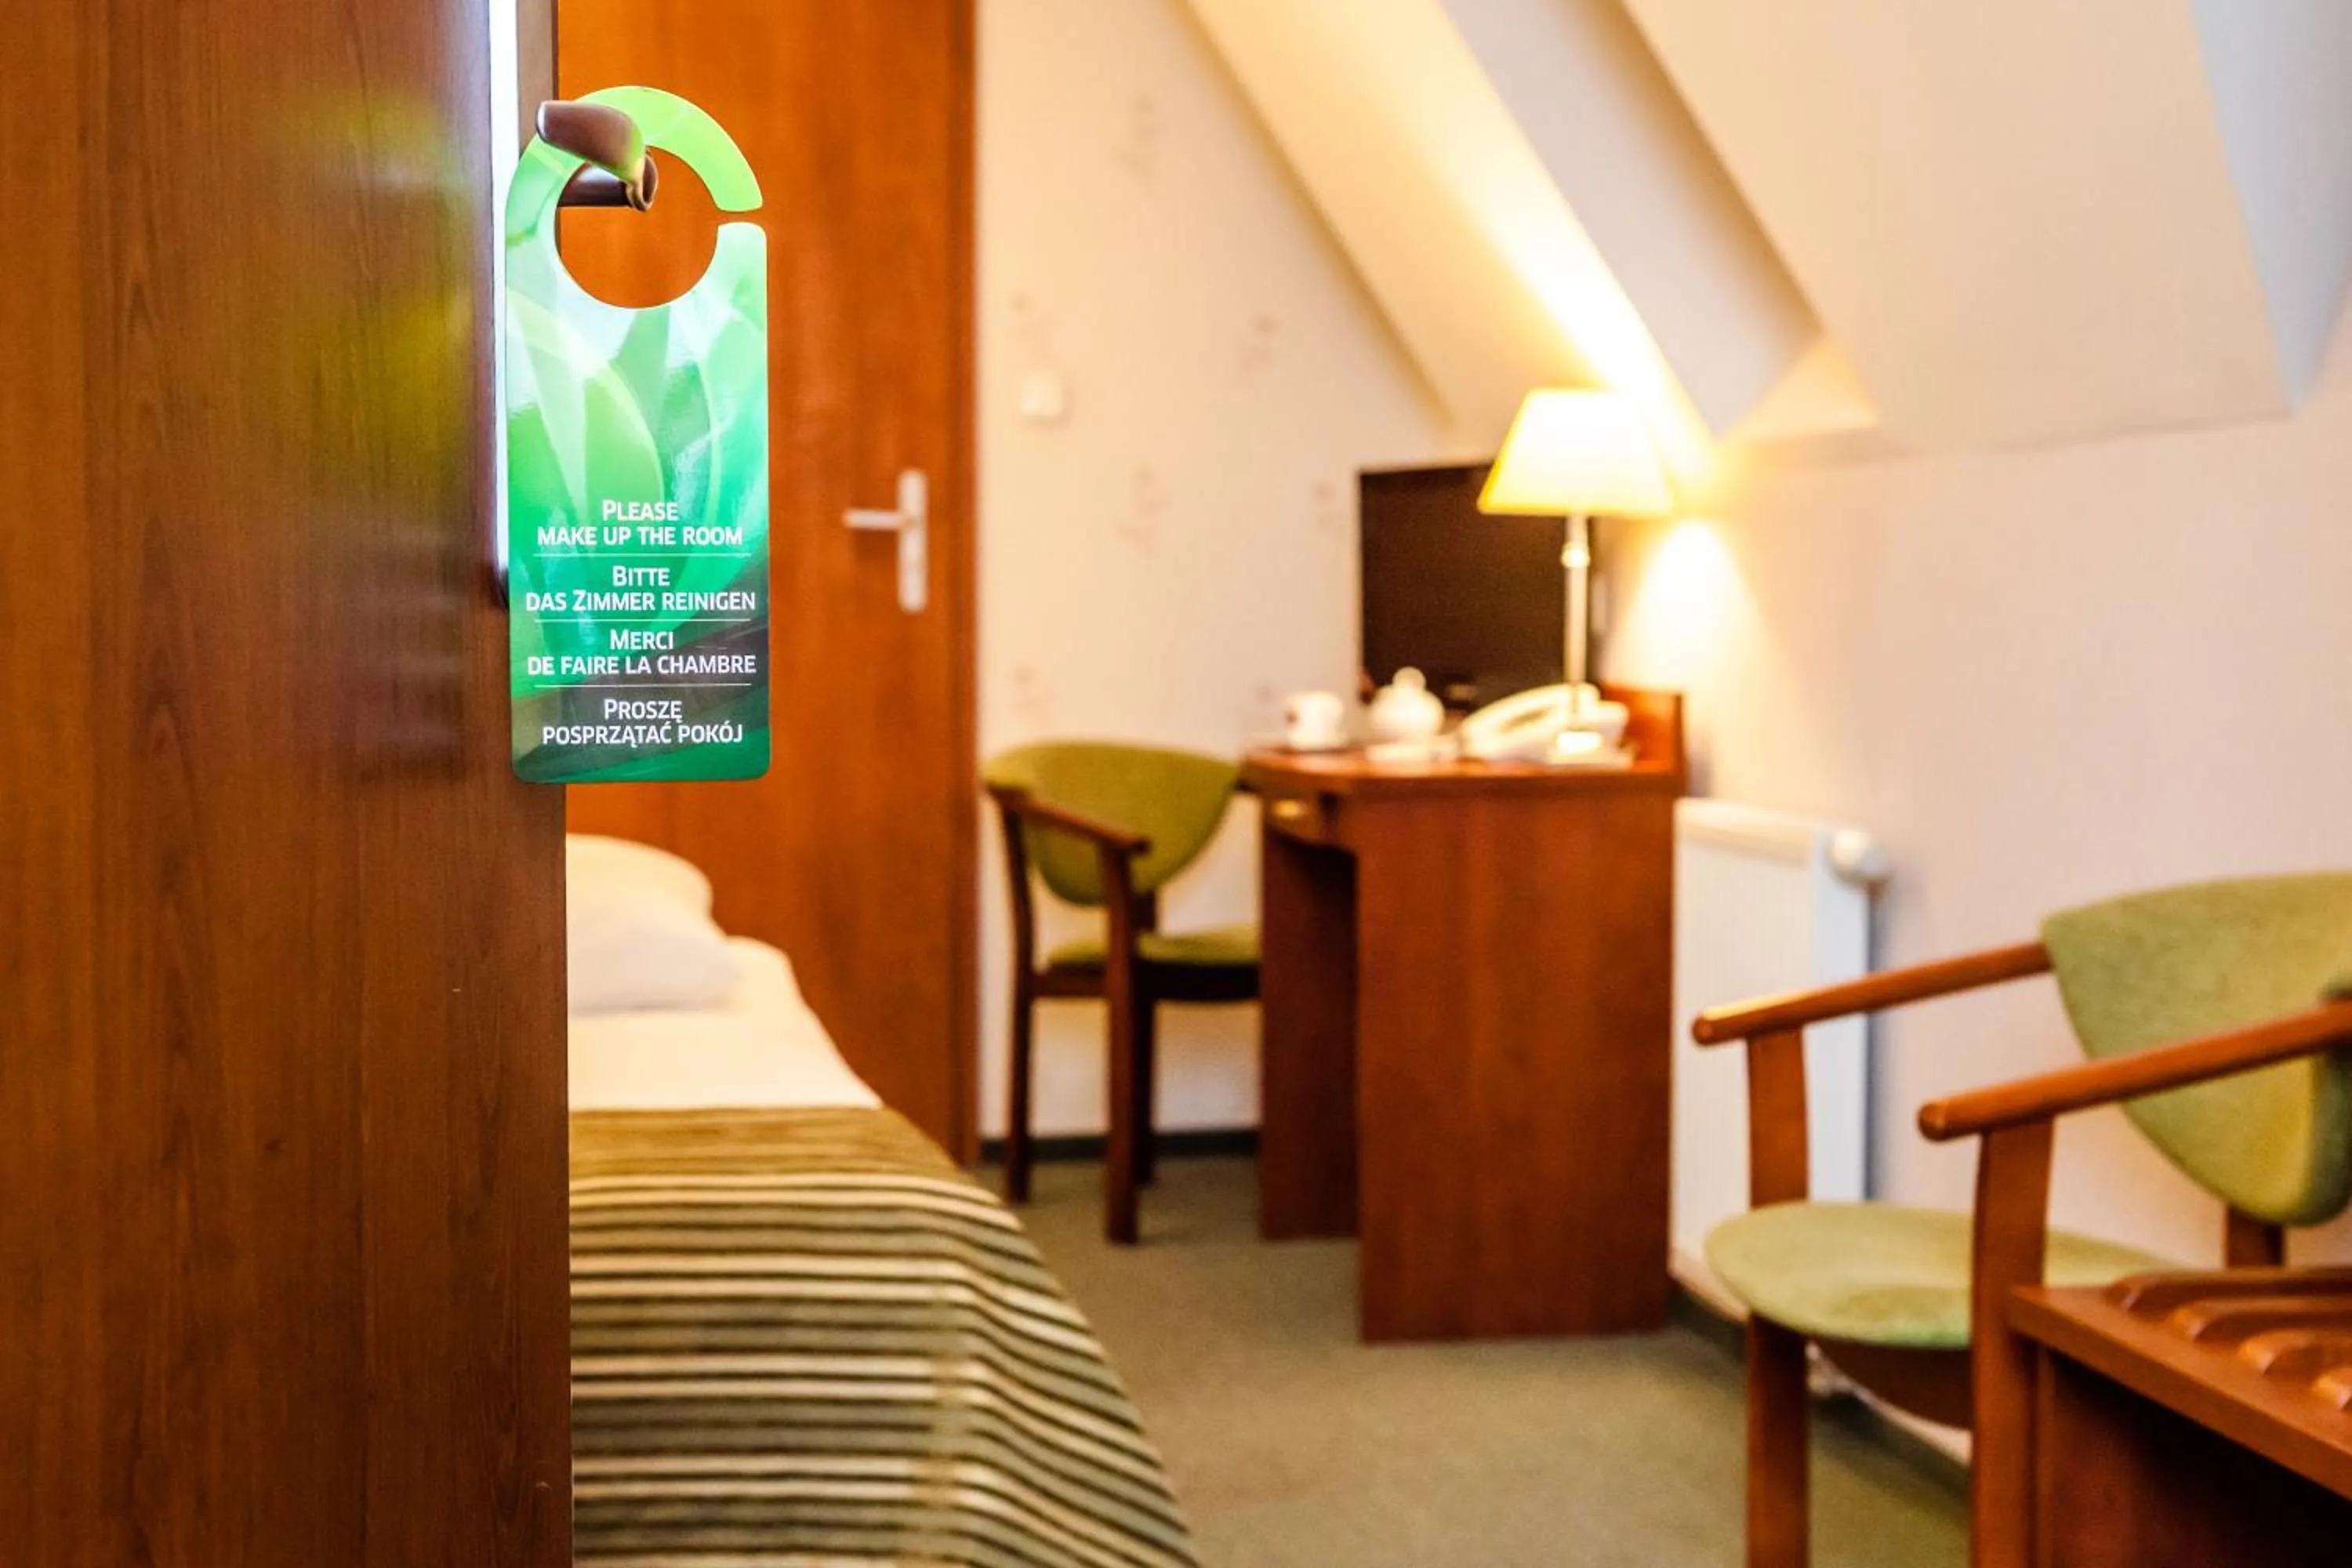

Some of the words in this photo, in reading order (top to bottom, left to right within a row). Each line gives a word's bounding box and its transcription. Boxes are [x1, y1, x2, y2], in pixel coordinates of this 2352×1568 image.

[602, 499, 678, 521] PLEASE
[537, 527, 597, 546] MAKE
[603, 526, 630, 545] UP
[637, 526, 676, 545] THE
[683, 526, 743, 545] ROOM
[612, 565, 670, 587] BITTE
[526, 593, 567, 612] DAS
[572, 590, 655, 612] ZIMMER
[662, 592, 756, 611] REINIGEN
[610, 629, 673, 650] MERCI
[527, 656, 554, 675] DE
[561, 656, 619, 675] FAIRE
[626, 656, 652, 674] LA
[657, 655, 757, 674] CHAMBRE
[604, 699, 682, 724] PROSZĘ
[543, 721, 672, 748] POSPRZĄTAĆ
[678, 720, 743, 743] POKÓJ
